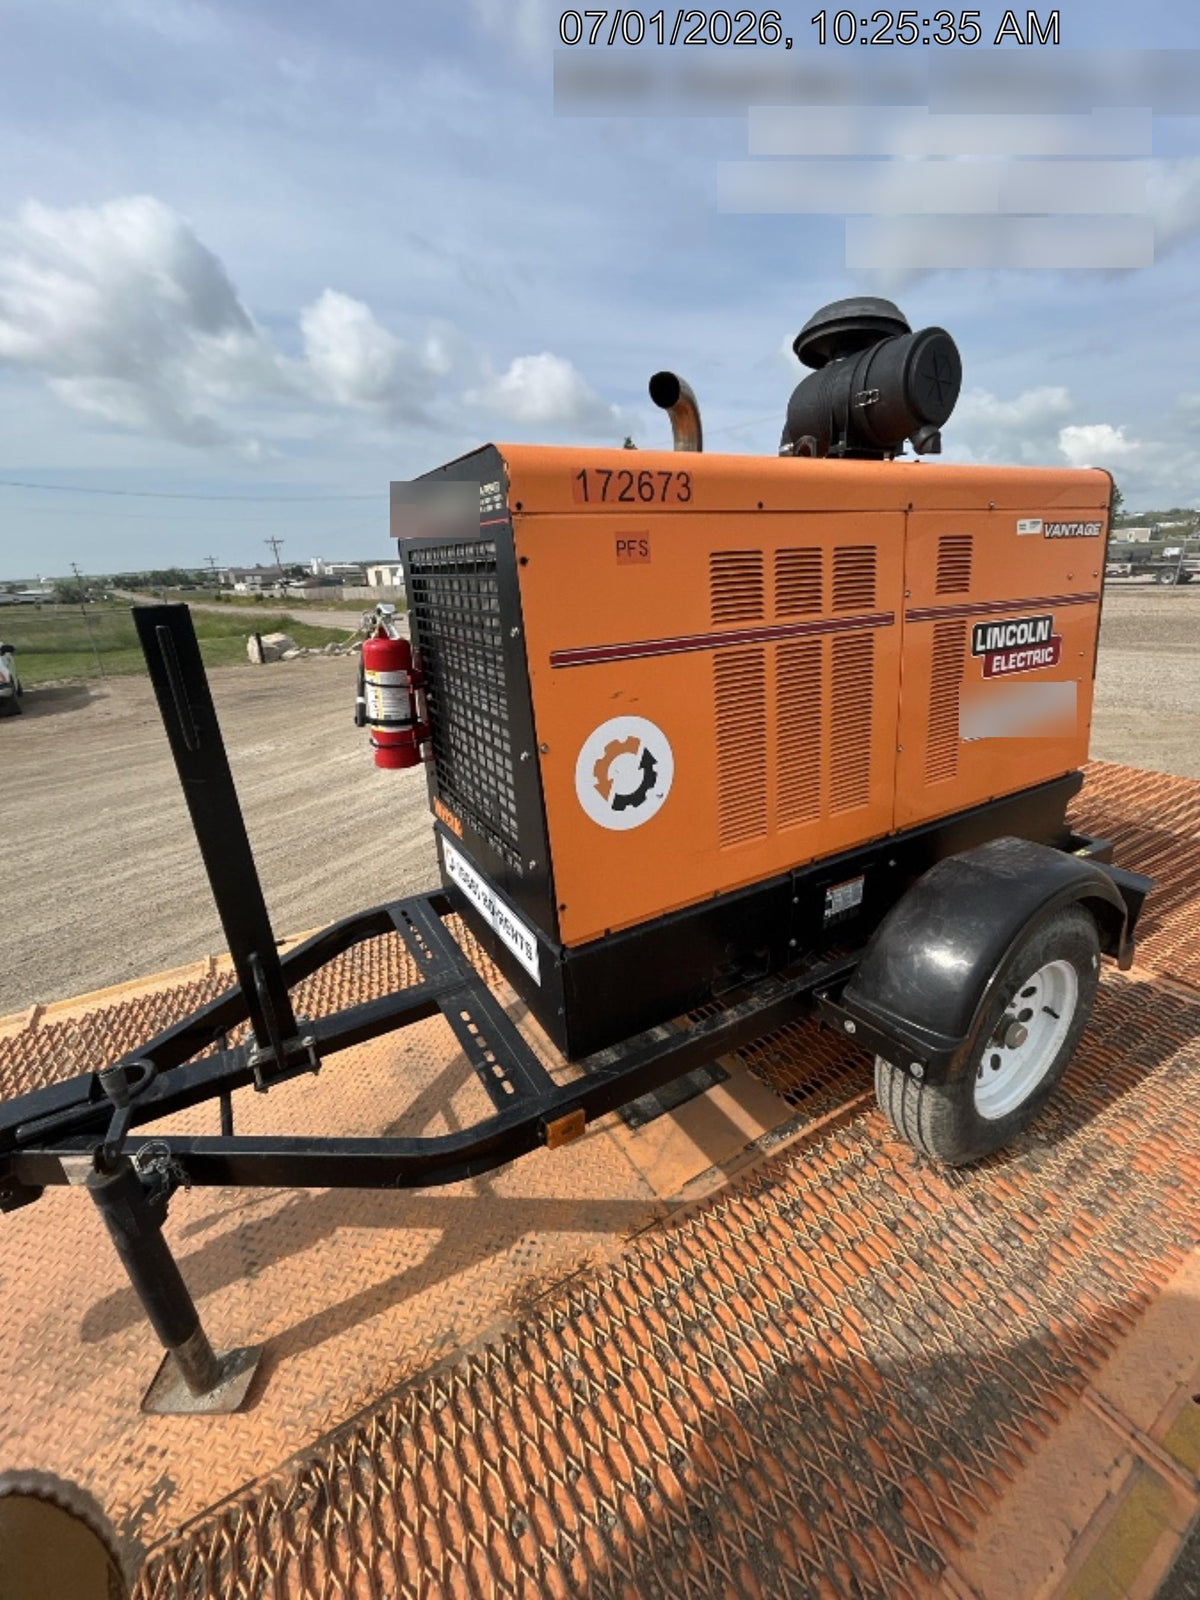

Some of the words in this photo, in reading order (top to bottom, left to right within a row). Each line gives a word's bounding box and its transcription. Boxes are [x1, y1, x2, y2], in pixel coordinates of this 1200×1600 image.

[576, 468, 691, 502] 172673
[1044, 522, 1102, 538] VANTAGE
[616, 539, 649, 557] PFS
[975, 620, 1050, 652] LINCOLN
[992, 646, 1054, 673] ELECTRIC
